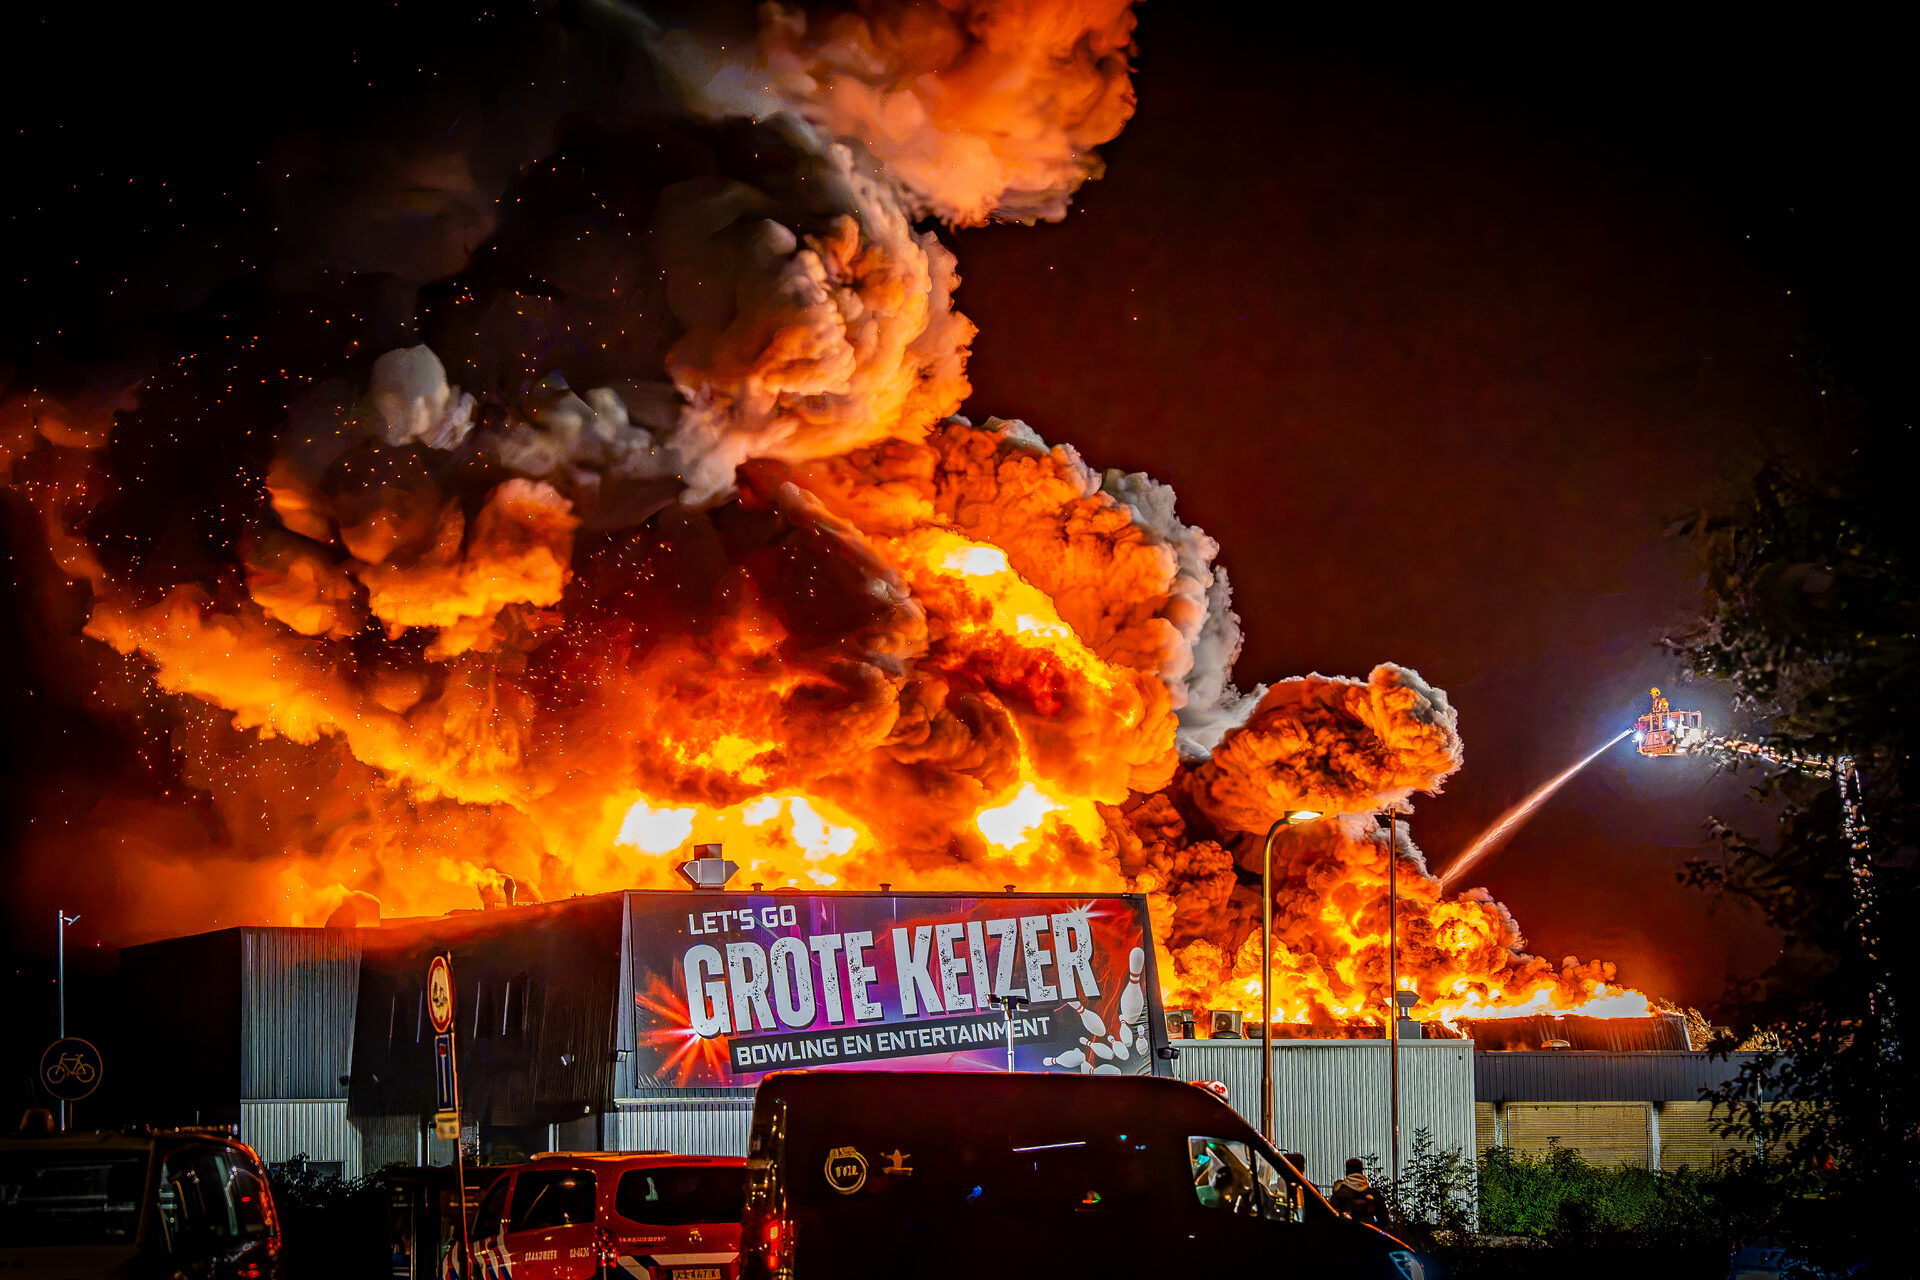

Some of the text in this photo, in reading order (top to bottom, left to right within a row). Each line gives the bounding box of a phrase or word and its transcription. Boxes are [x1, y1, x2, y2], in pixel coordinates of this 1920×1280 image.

[688, 905, 797, 935] LET'S GO
[683, 913, 1100, 1037] GROTE KEIZER
[736, 1016, 1050, 1066] BOWLING EN ENTERTAINMENT
